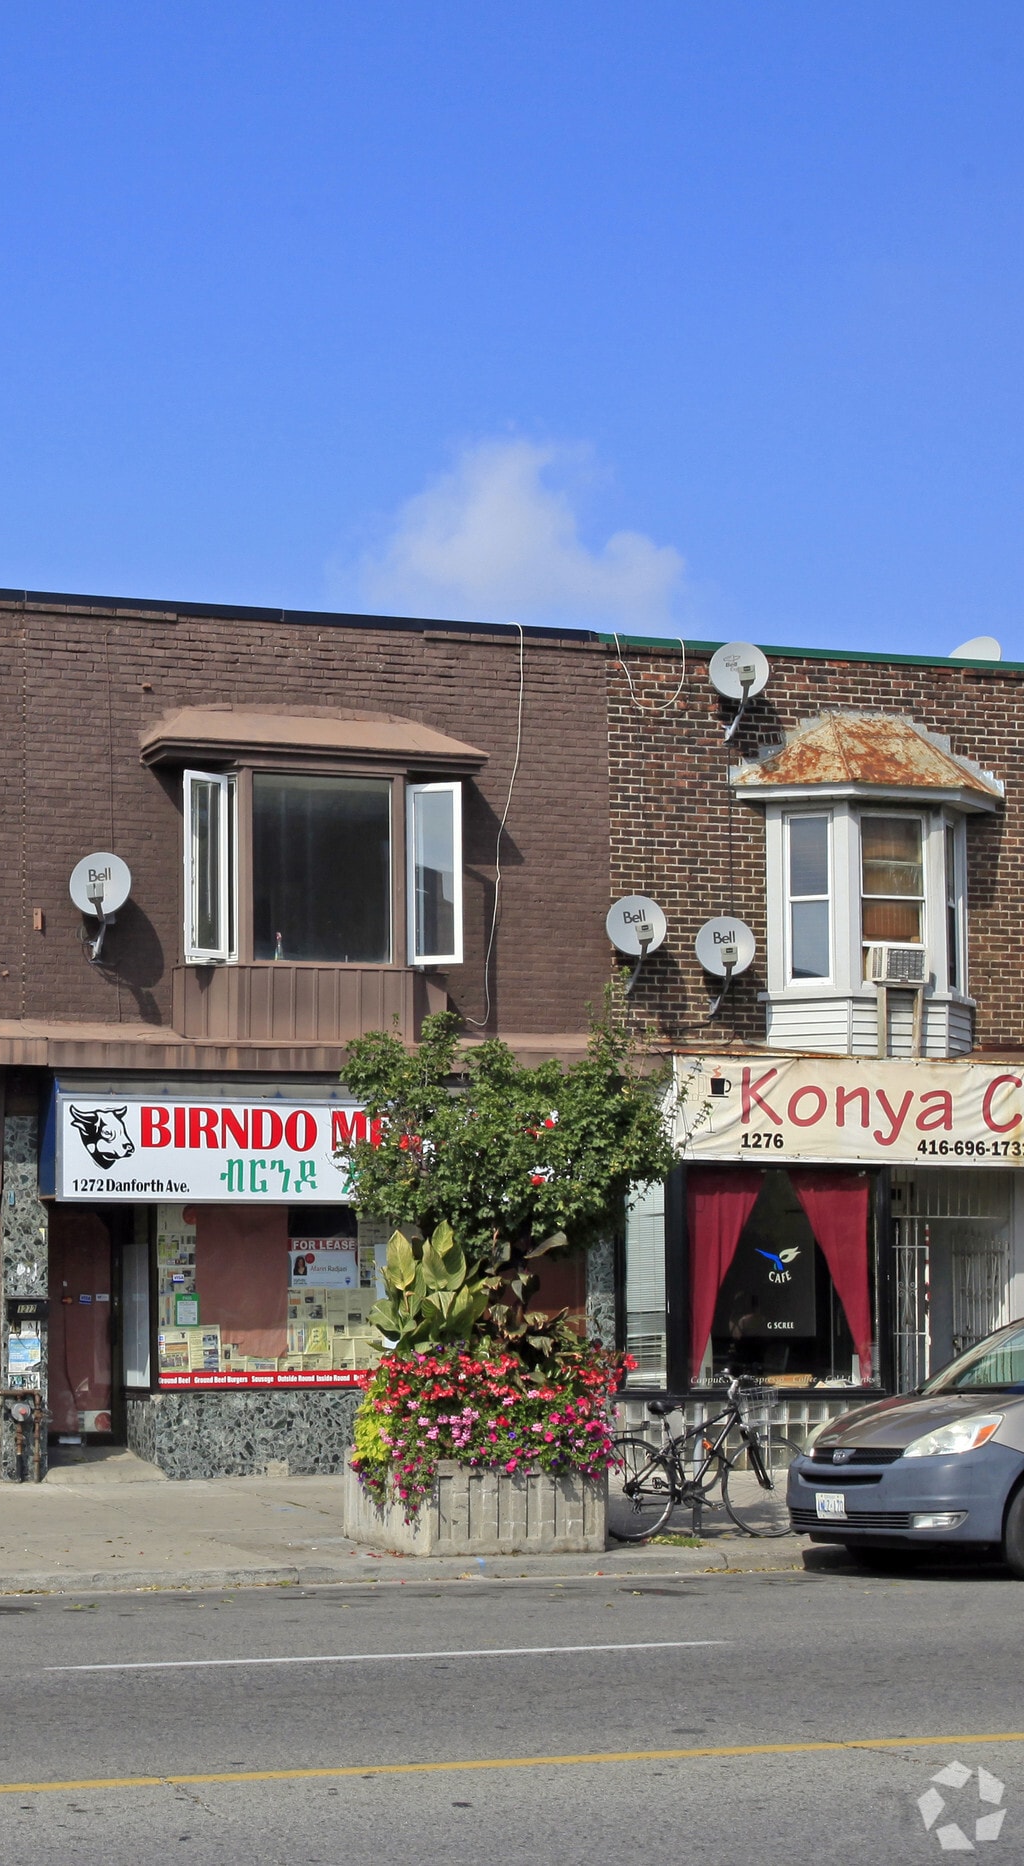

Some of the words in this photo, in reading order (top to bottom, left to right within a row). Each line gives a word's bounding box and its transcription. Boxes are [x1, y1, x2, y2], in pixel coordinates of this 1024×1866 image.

[88, 867, 112, 882] Bell
[622, 909, 646, 924] Bell
[712, 930, 736, 944] Bell
[740, 1066, 953, 1146] Konya
[140, 1106, 318, 1152] BIRNDO
[740, 1133, 784, 1149] 1276
[917, 1139, 1024, 1156] 416-696-173
[72, 1178, 104, 1192] 1272
[105, 1178, 164, 1193] Danforth
[165, 1181, 190, 1193] Ave.
[293, 1240, 316, 1250] FOR
[319, 1240, 356, 1250] LEASE
[768, 1270, 792, 1283] CAFE
